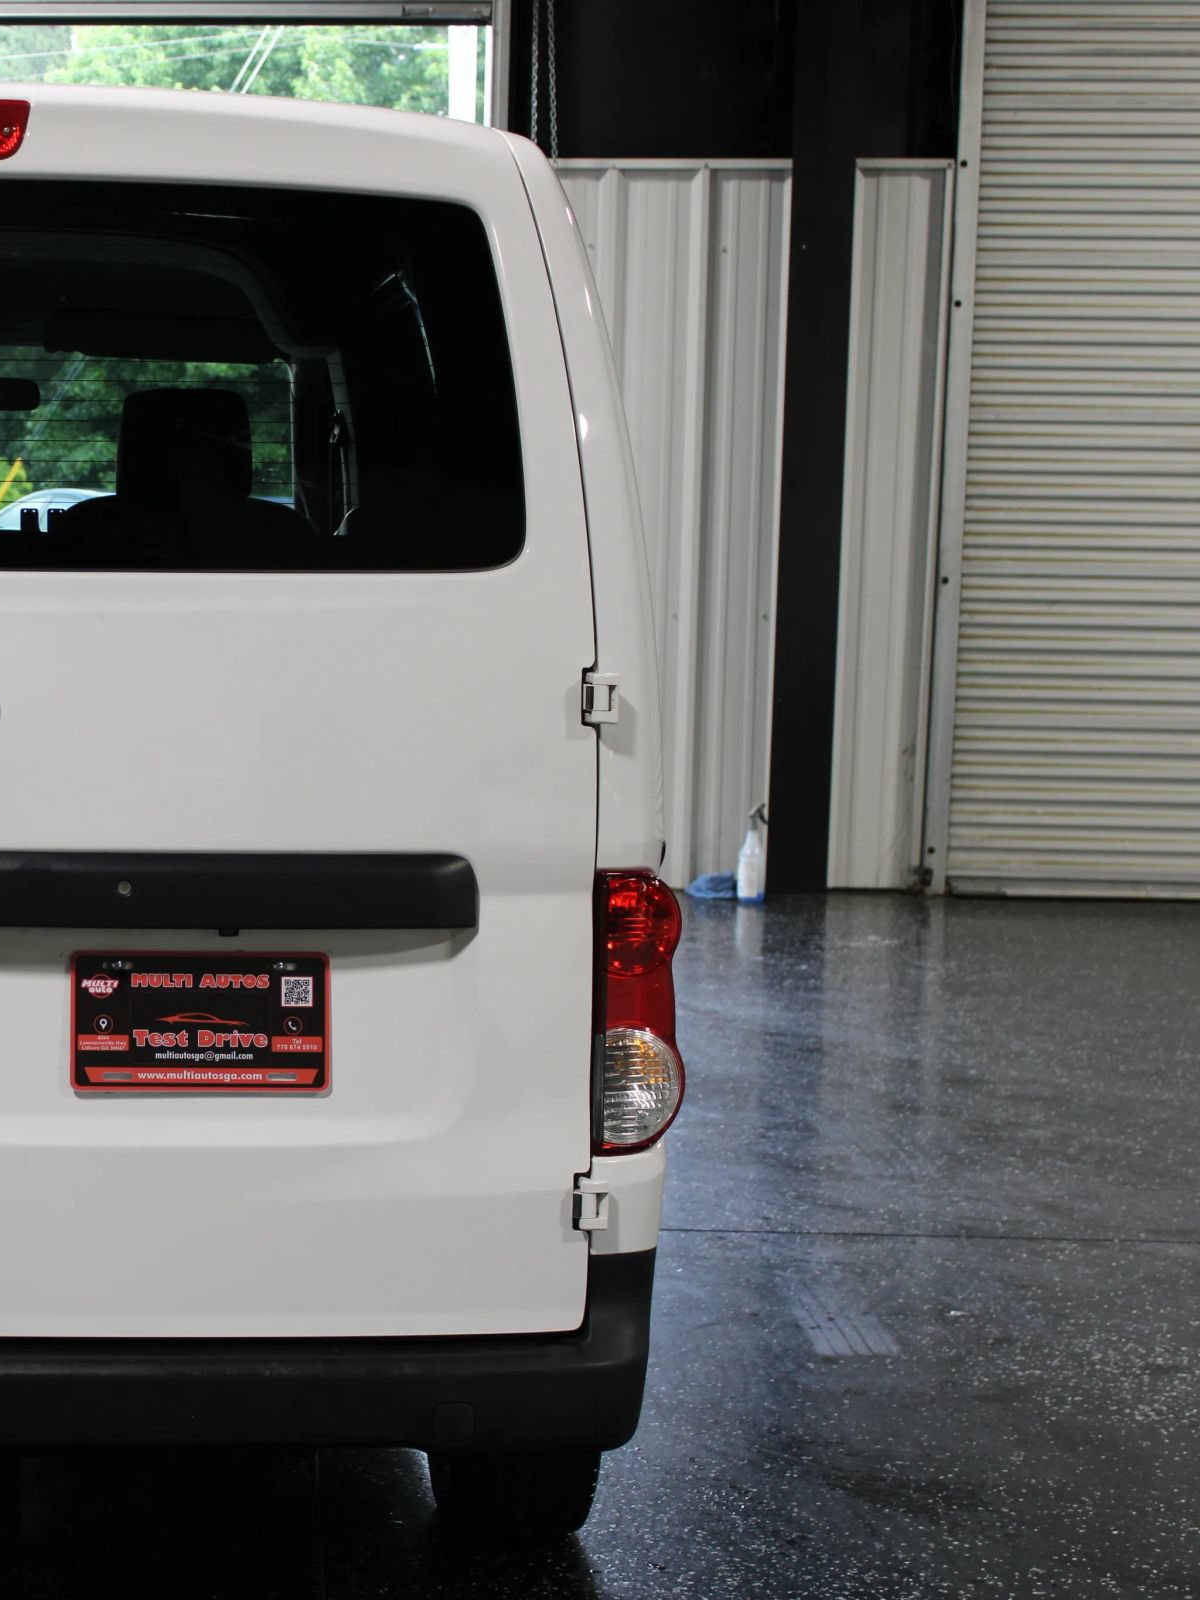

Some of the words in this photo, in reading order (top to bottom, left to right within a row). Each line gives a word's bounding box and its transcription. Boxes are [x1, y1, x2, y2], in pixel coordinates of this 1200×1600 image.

[81, 979, 119, 988] MULTI
[130, 973, 193, 988] MULTI
[199, 974, 270, 989] AUTOS
[132, 1029, 189, 1047] Test
[197, 1029, 268, 1047] Drive
[155, 1051, 254, 1061] multiautosga@gmail.com
[137, 1070, 263, 1083] www.multiautosga.com
